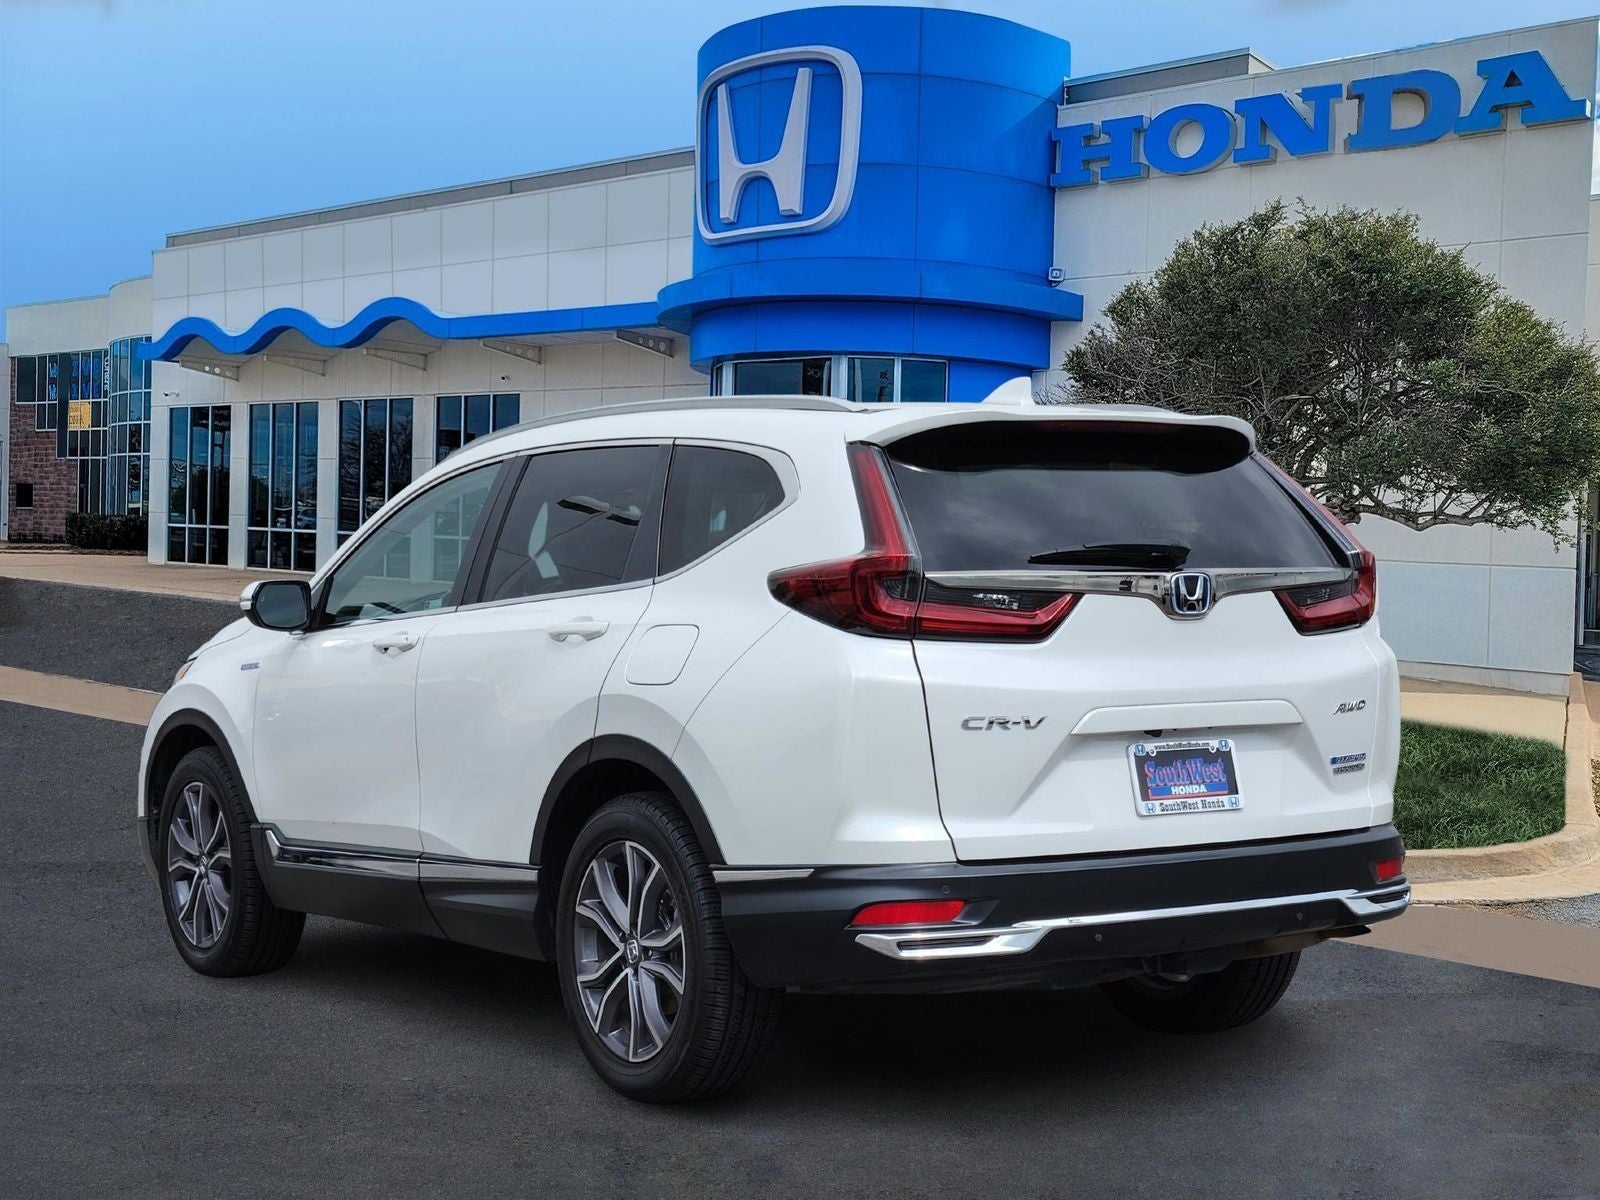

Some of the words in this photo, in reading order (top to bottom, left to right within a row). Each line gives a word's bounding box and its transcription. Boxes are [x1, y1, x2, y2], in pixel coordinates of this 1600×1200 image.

[1050, 50, 1592, 189] HONDA
[1333, 699, 1366, 715] AWD
[960, 715, 1048, 731] CR-V
[1144, 757, 1228, 787] SouthWest
[1170, 784, 1208, 795] HONDA
[1159, 800, 1200, 812] SouthWest
[1201, 798, 1226, 809] Honda
